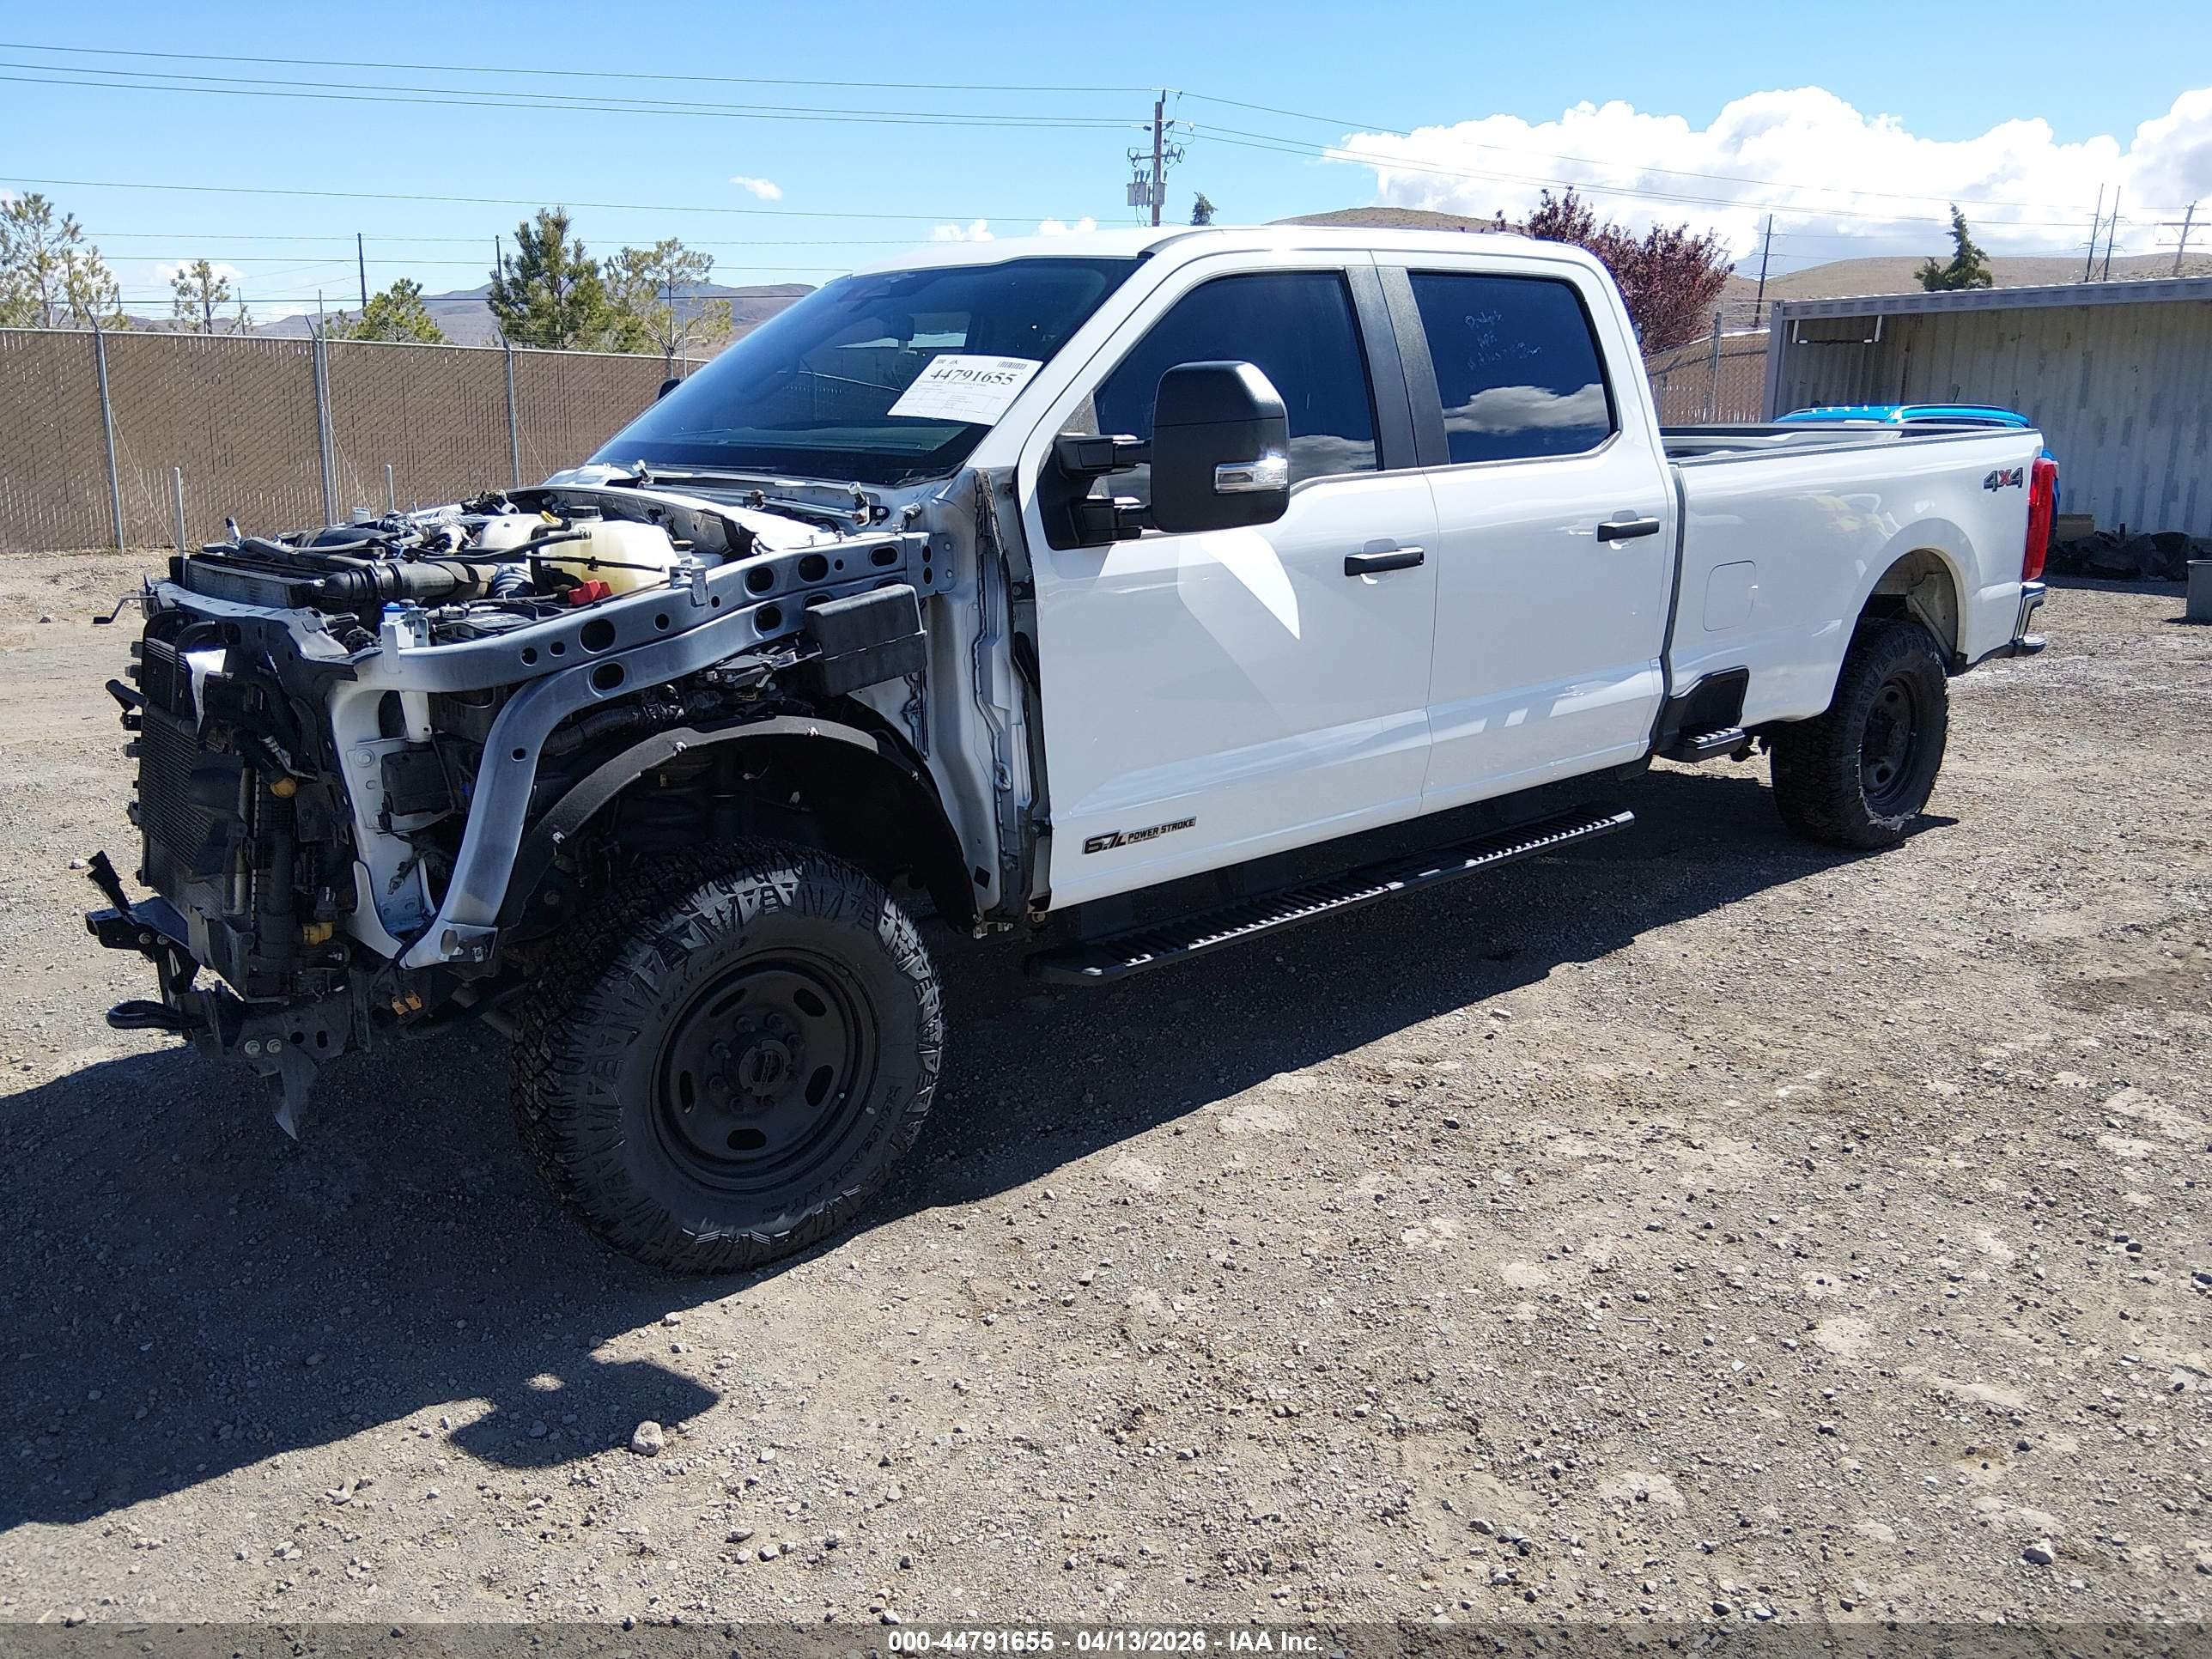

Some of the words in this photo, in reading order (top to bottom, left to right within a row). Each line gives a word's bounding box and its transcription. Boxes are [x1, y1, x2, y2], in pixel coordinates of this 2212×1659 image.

[930, 368, 1018, 386] 44791655
[1083, 830, 1127, 854] 6.7L
[1128, 826, 1159, 841] POWER
[1160, 817, 1196, 834] STROKE
